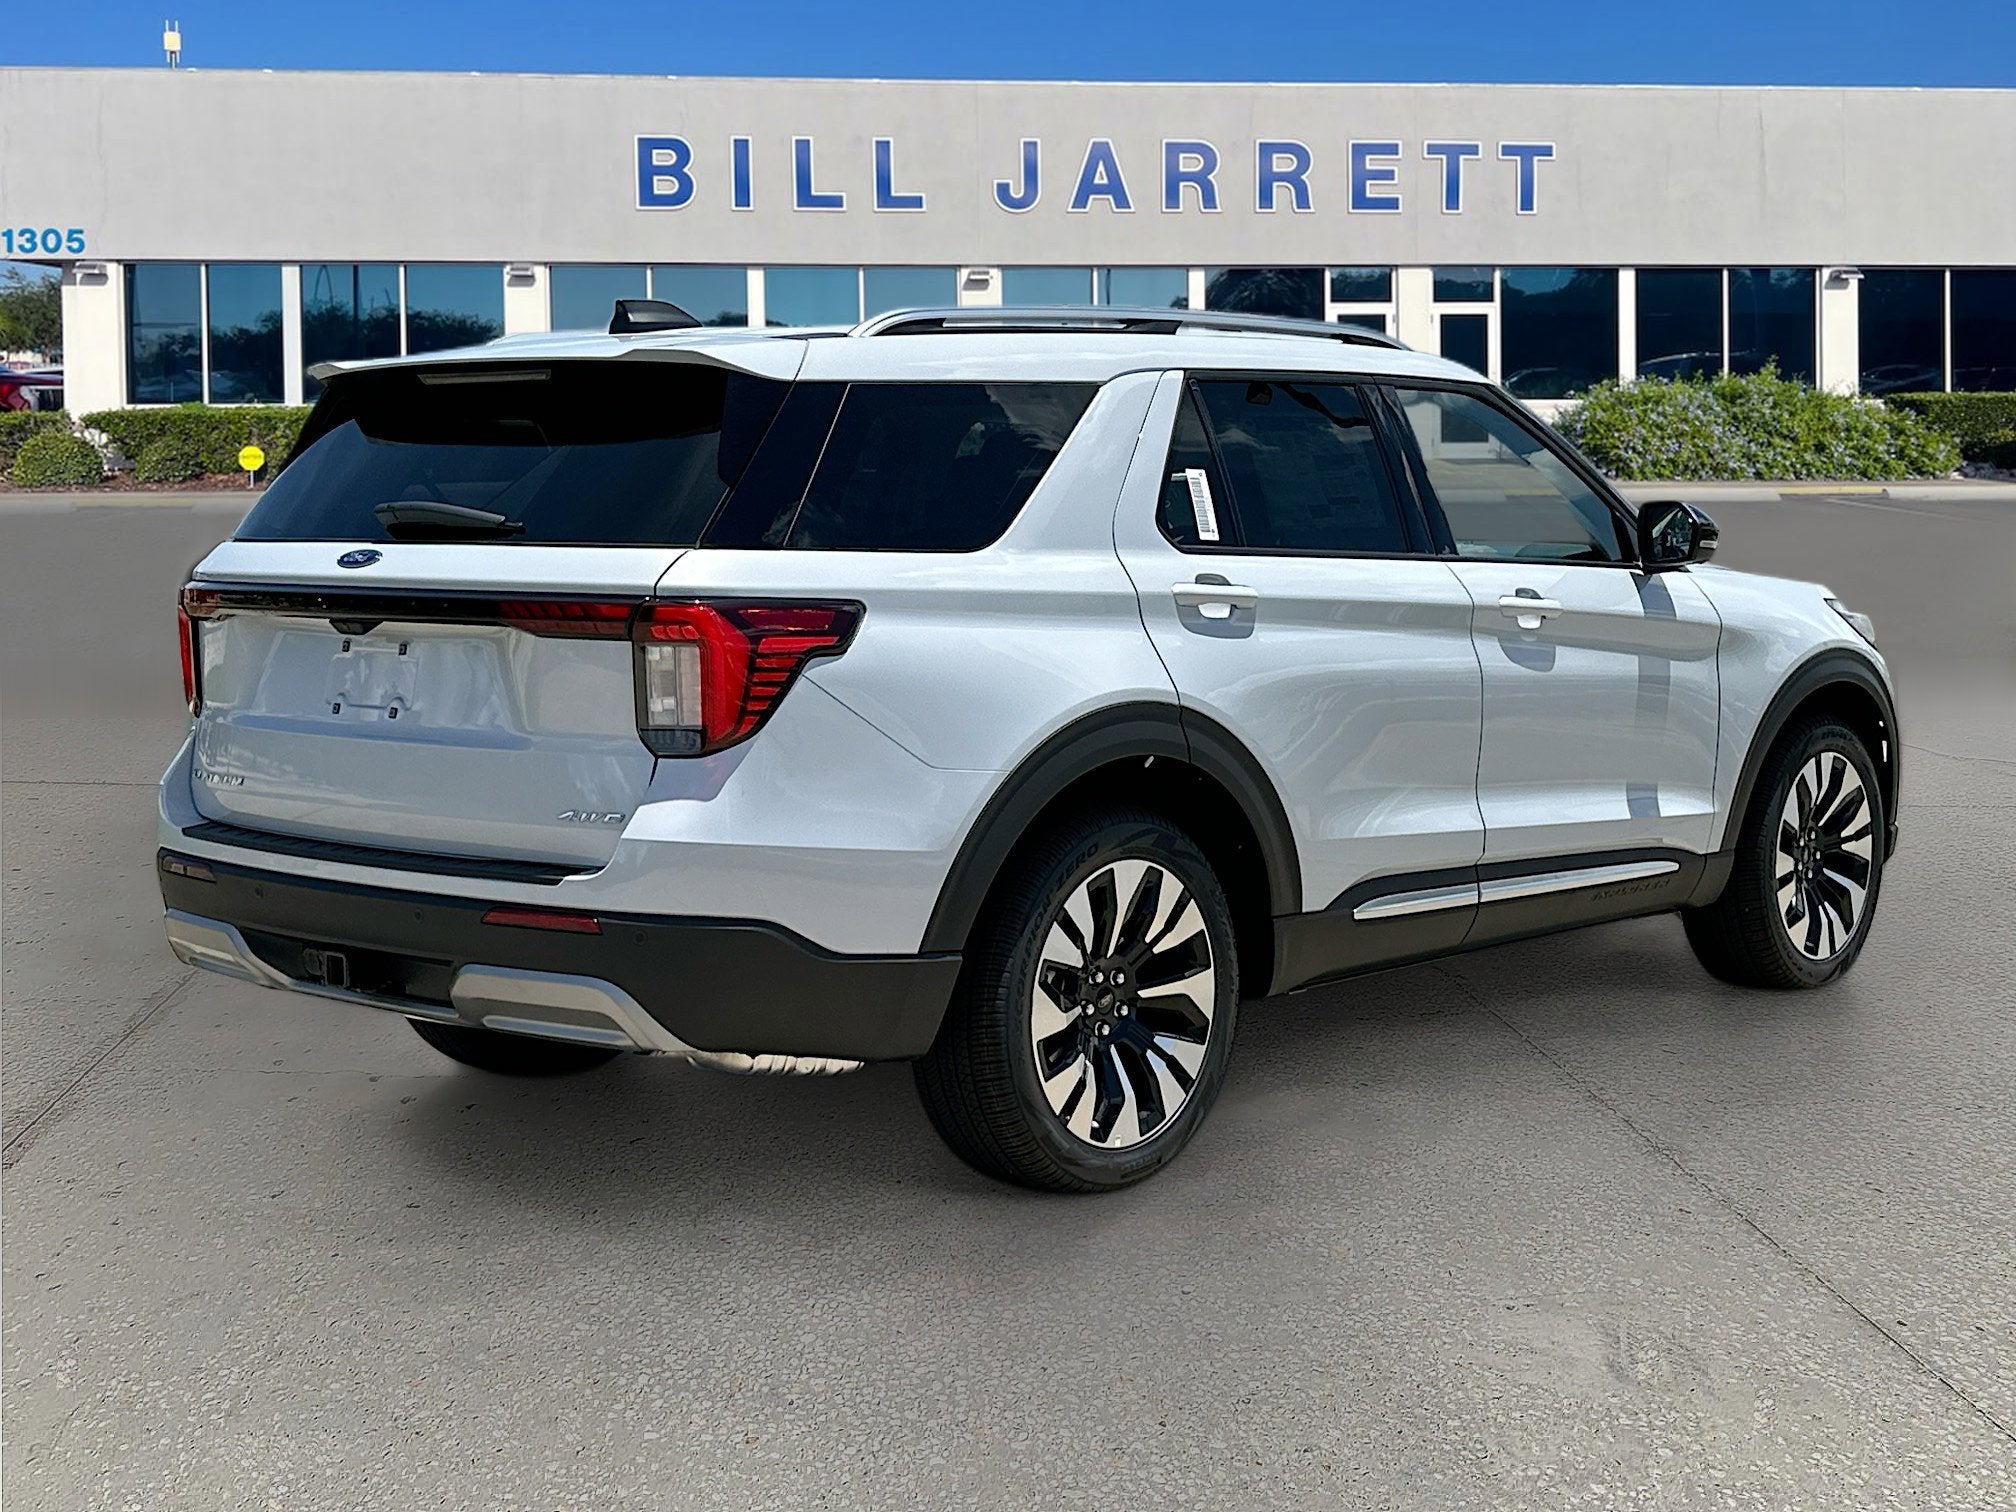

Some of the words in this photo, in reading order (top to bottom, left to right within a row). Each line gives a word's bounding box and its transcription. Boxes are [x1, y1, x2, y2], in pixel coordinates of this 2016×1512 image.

[633, 133, 927, 214] BILL
[992, 138, 1557, 216] JARRETT
[0, 227, 86, 254] 1305
